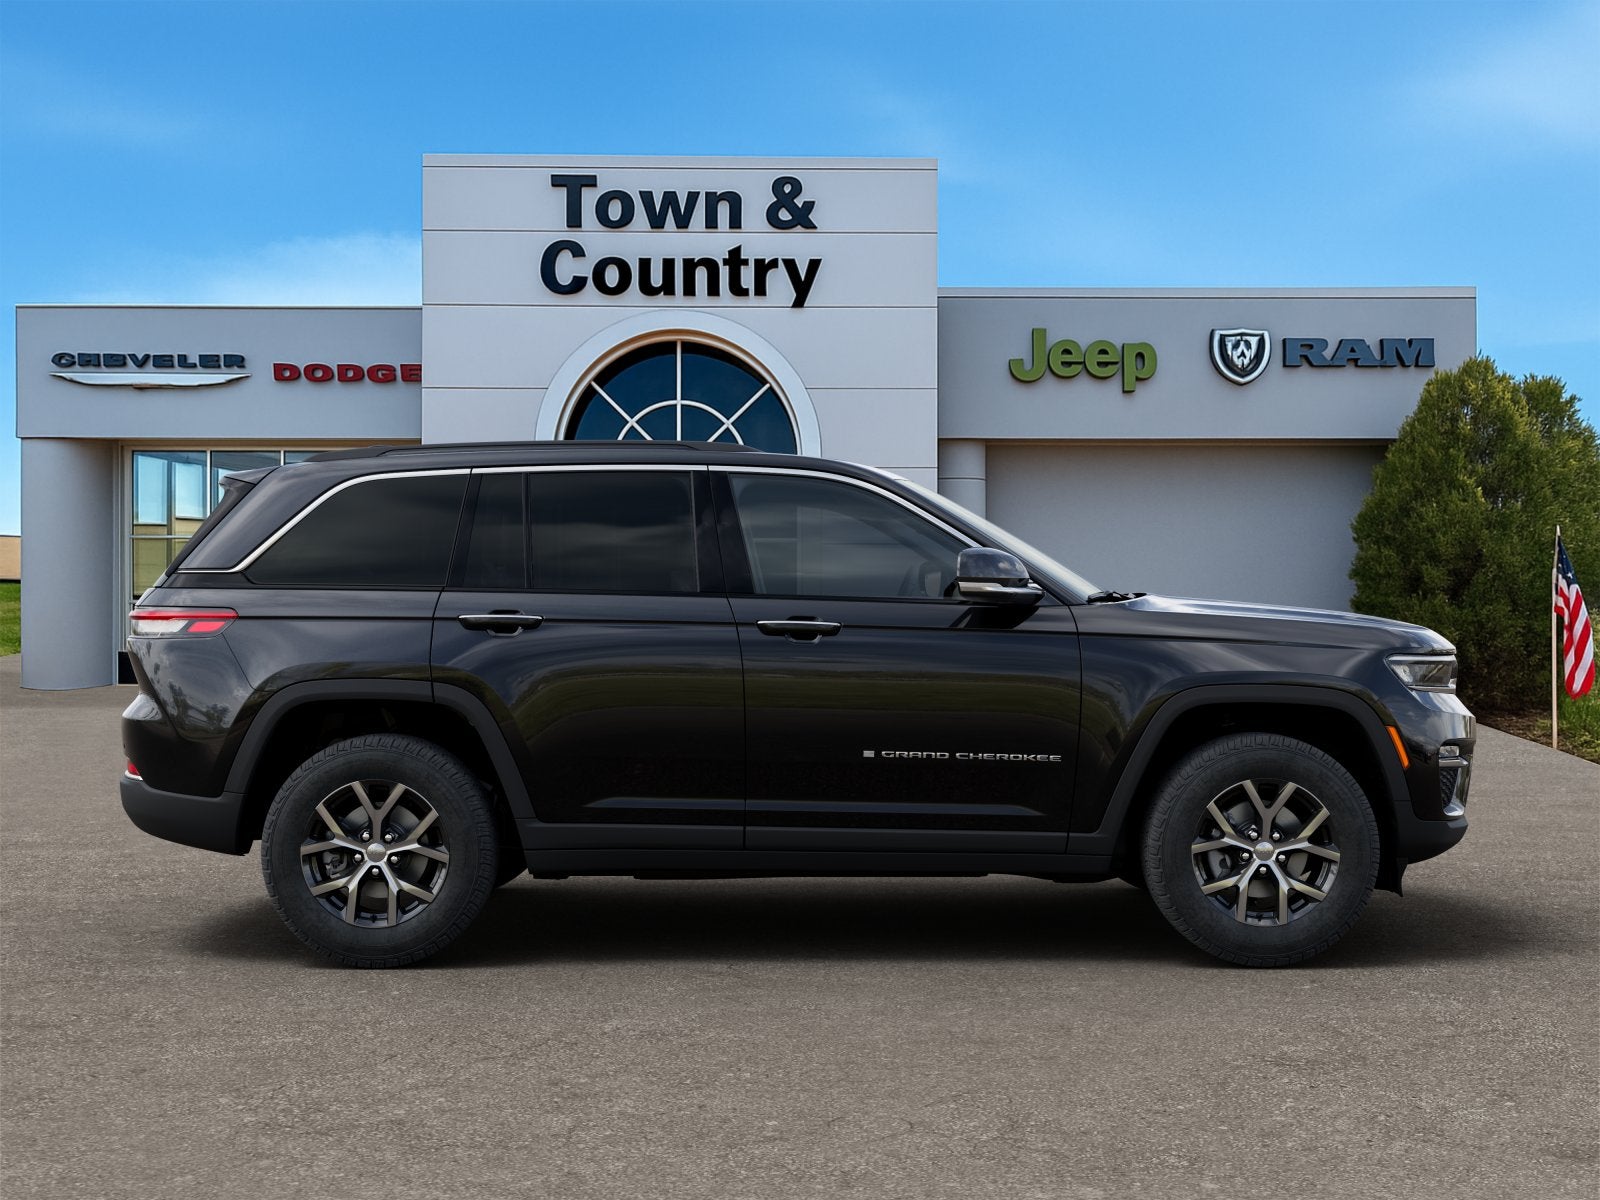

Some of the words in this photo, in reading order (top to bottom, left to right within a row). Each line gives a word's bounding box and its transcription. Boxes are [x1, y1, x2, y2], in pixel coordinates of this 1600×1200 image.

[551, 174, 742, 229] Town
[766, 175, 818, 230] &
[540, 240, 822, 307] Country
[273, 362, 421, 383] DODGE
[1009, 328, 1157, 393] Jeep
[1283, 337, 1436, 368] RAM
[881, 750, 950, 759] GRAND
[955, 752, 1062, 762] CHEROKEE
